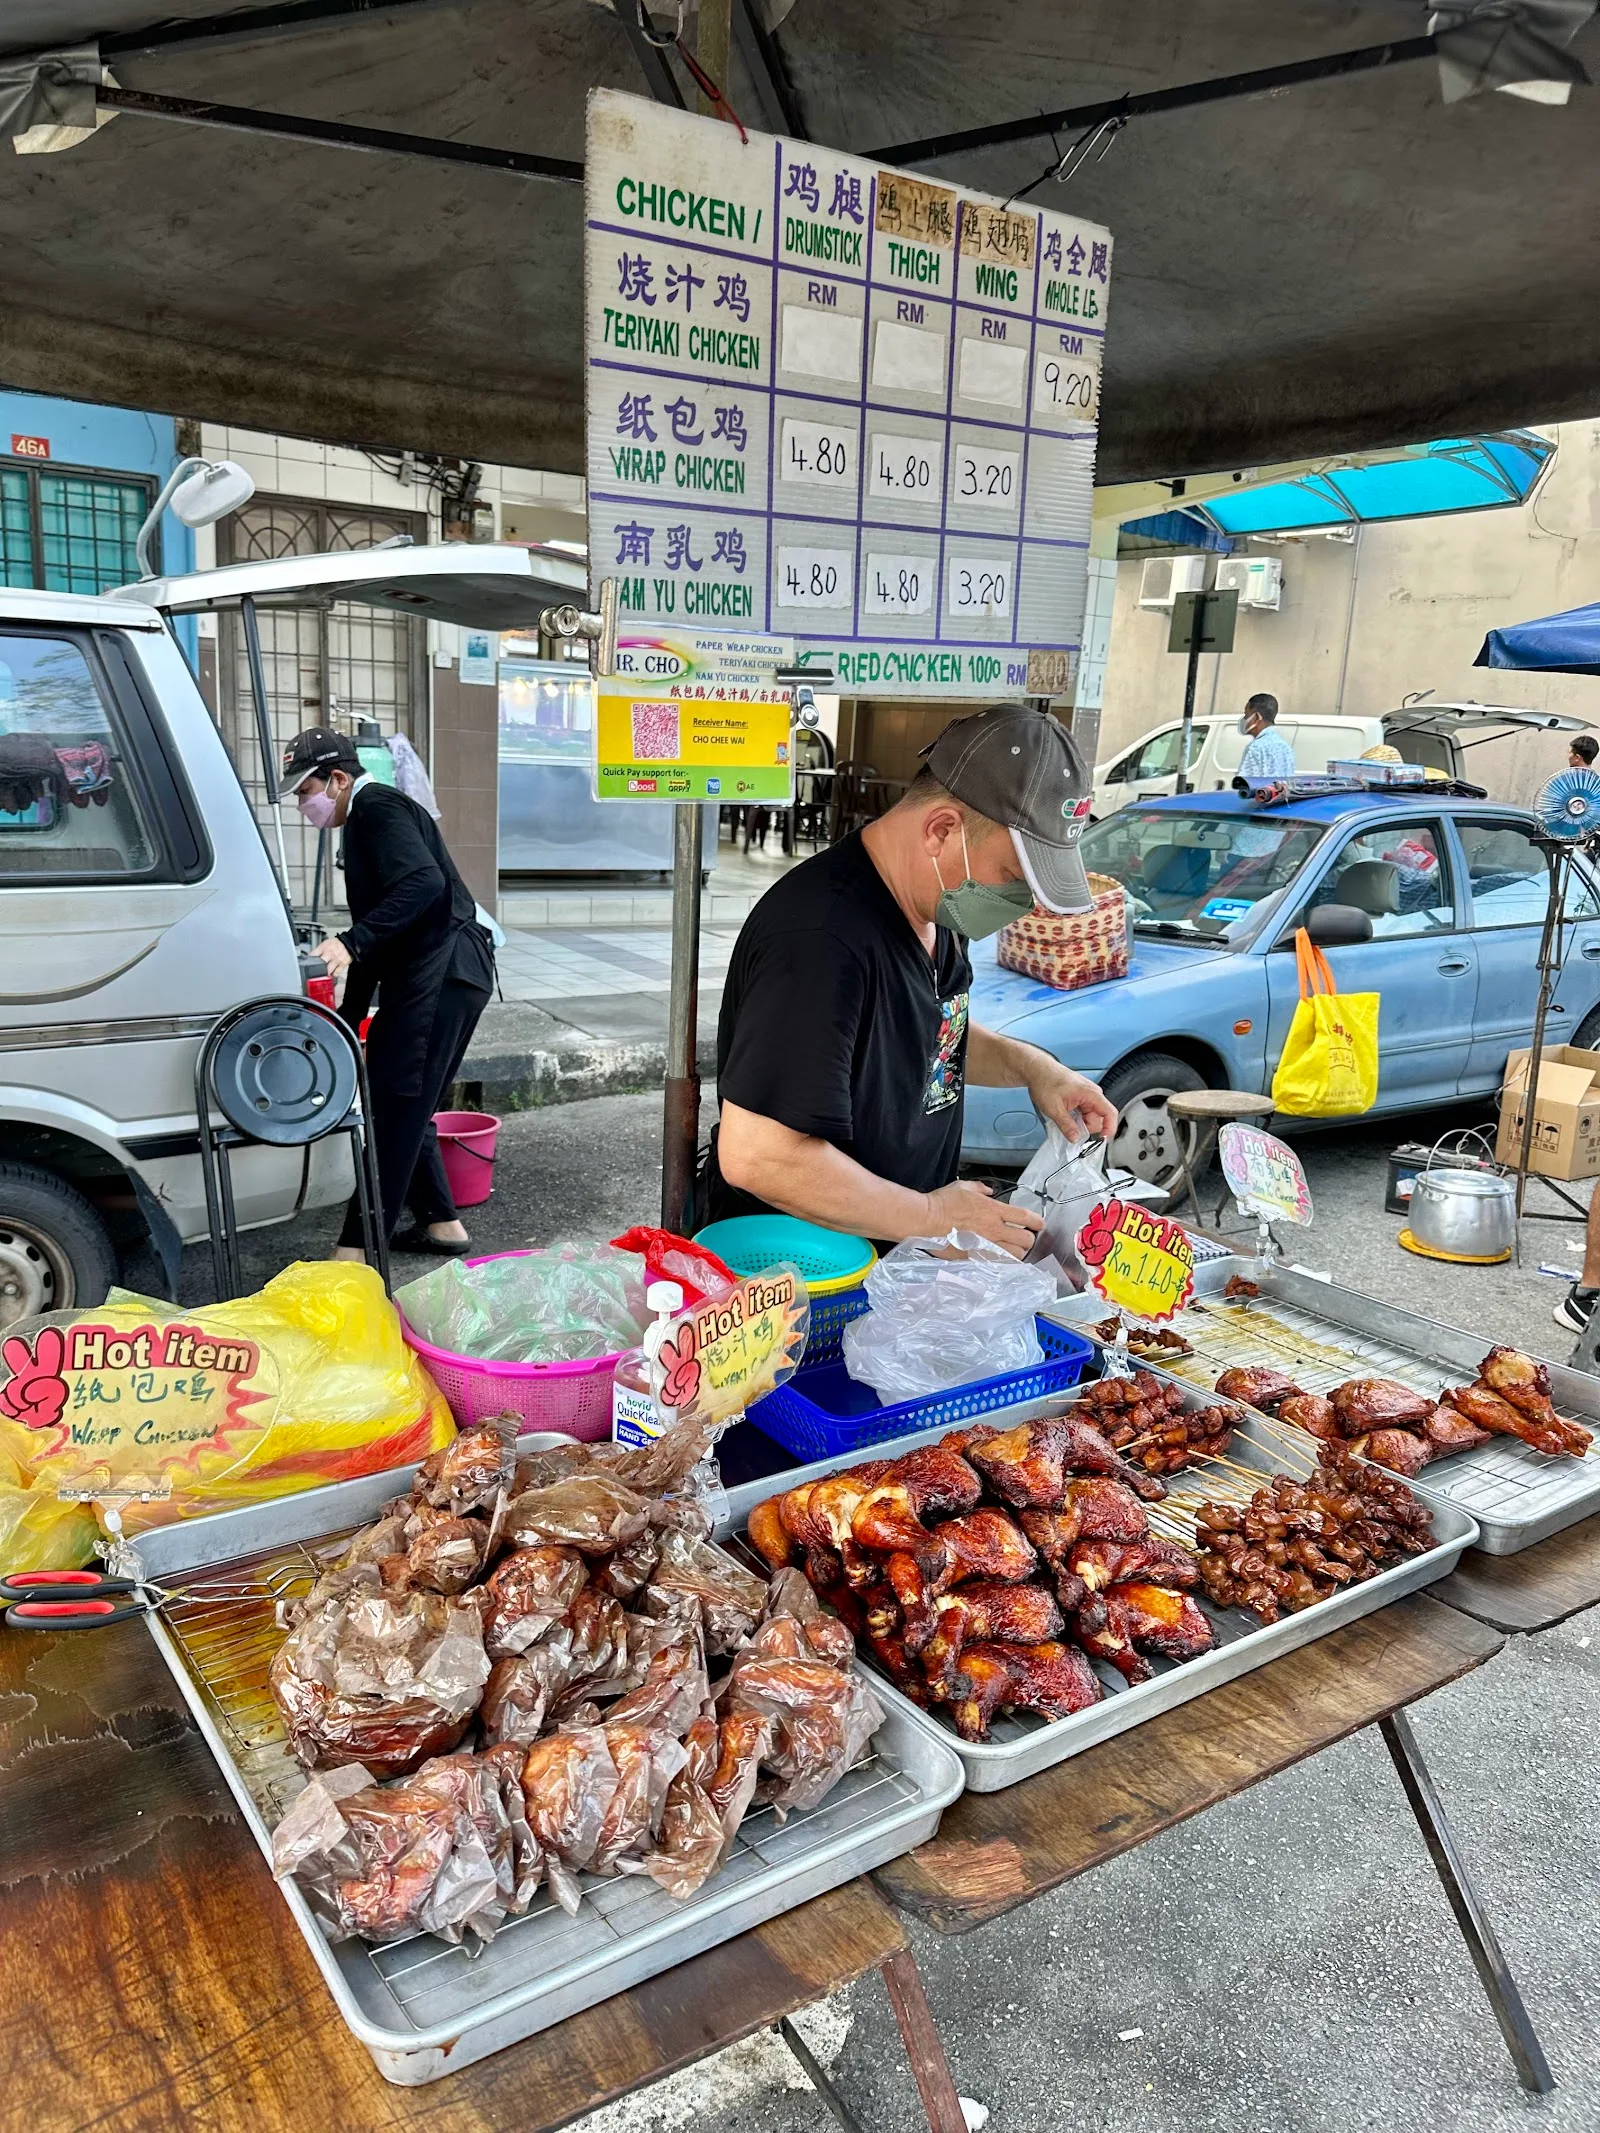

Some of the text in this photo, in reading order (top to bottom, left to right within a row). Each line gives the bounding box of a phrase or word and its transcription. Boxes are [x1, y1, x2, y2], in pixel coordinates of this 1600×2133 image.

[616, 176, 745, 240] CHICKEN
[784, 162, 865, 225] 鸡腿
[785, 217, 863, 267] DRUMSTICK
[1043, 228, 1108, 284] 鸡全腿
[888, 242, 940, 285] THIGH
[617, 252, 751, 322] 烧汁鸡
[808, 282, 837, 307] RM
[976, 264, 1018, 301] WING
[1045, 280, 1079, 316] WHOLE
[897, 300, 924, 324] RM
[981, 318, 1007, 340] RM
[603, 307, 760, 370] TERIYAKI CHICKEN
[1059, 334, 1083, 355] RM
[1044, 362, 1092, 408] 9.20
[615, 391, 748, 452] 纸包鸡
[16, 439, 47, 456] 46A
[791, 436, 846, 475] 4.80
[608, 446, 745, 494] WRAP CHICKEN
[879, 451, 930, 488] 4.80
[960, 460, 1012, 496] 3.20
[613, 520, 747, 574] 南乳鸡
[620, 576, 752, 617] AM YU CHICKEN
[786, 564, 837, 597] 4.80
[877, 570, 918, 602] 4.80
[958, 570, 1005, 605] 3.20
[645, 655, 679, 674] CHO
[696, 641, 783, 655] PAPER WRAP CHICKEN
[719, 658, 790, 670] TERIYAKI CHICKEN
[695, 672, 760, 684] NAM YU CHICKEN
[883, 653, 961, 684] CHICKEN
[1007, 664, 1026, 686] RM
[693, 717, 748, 728] Receiver Name:
[693, 735, 745, 745] CHO CHEE WAI
[603, 768, 625, 777] Quick
[627, 768, 640, 778] Pay
[642, 769, 671, 779] support
[1241, 1134, 1297, 1172] Hot item
[1121, 1208, 1164, 1249] Hot
[698, 1279, 792, 1348] Hot item
[73, 1331, 251, 1373] Hot item
[617, 1402, 661, 1426] QuicKlea
[626, 1396, 652, 1412] hovid
[618, 1428, 640, 1443] HAND
